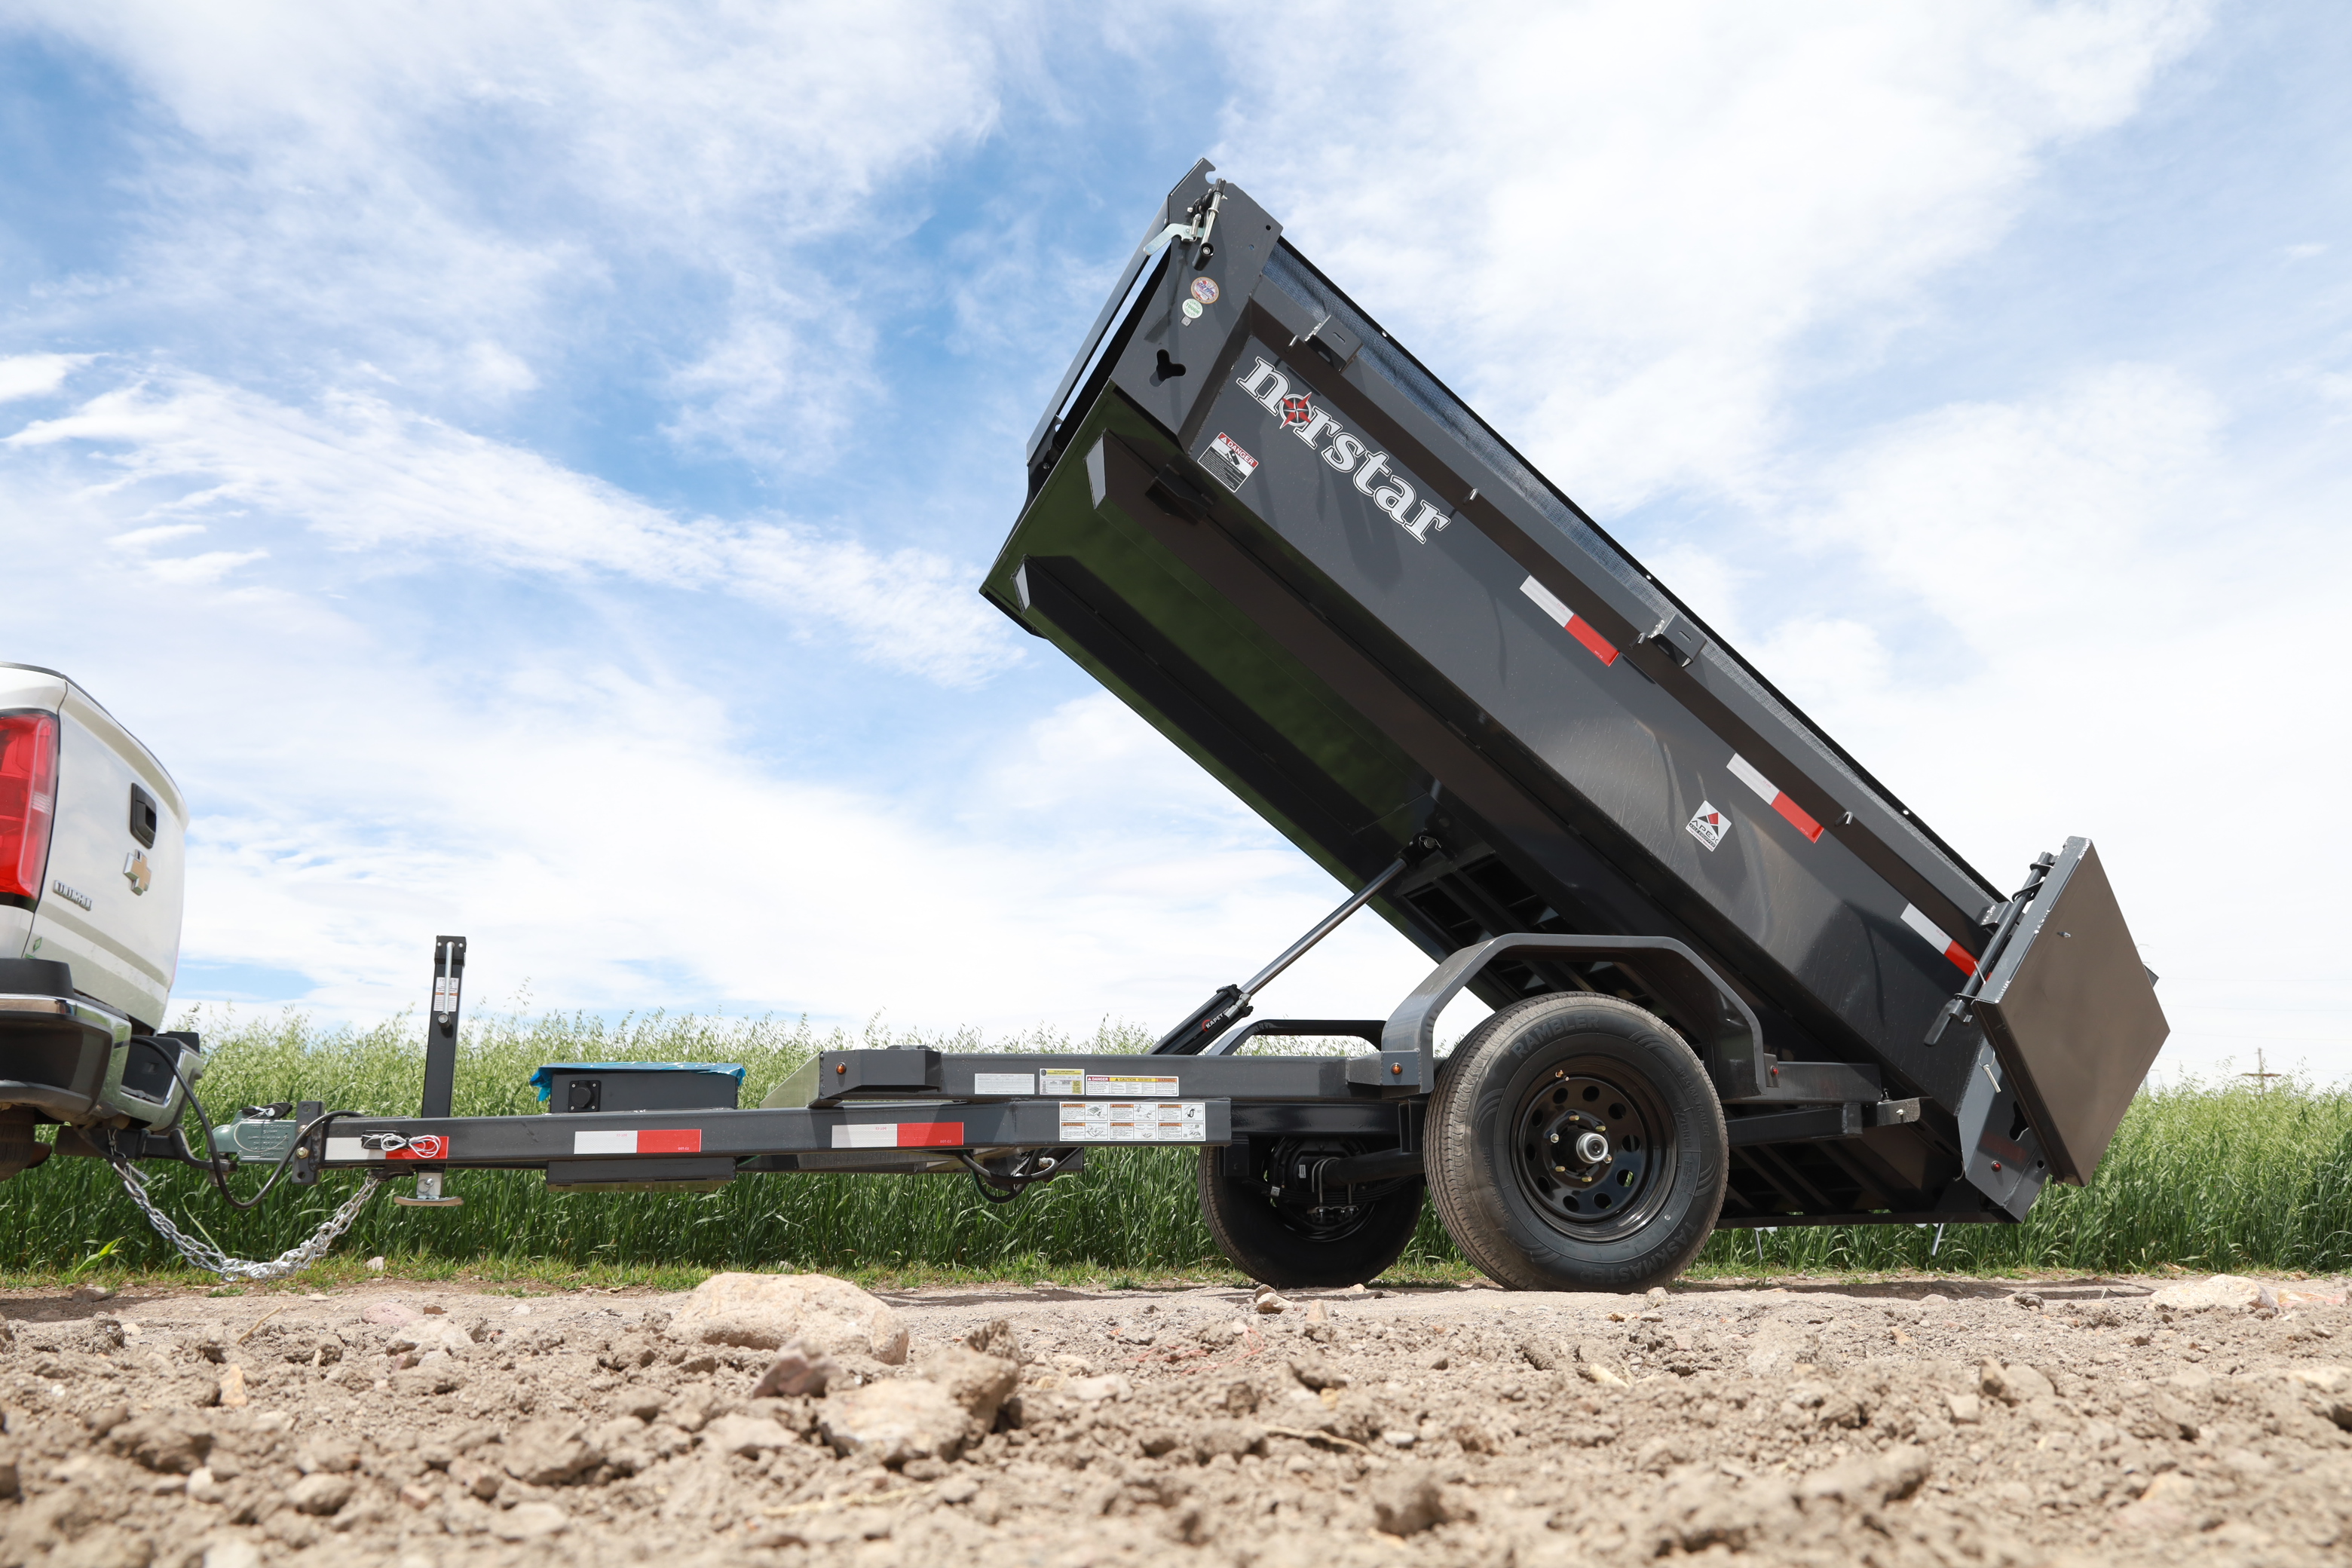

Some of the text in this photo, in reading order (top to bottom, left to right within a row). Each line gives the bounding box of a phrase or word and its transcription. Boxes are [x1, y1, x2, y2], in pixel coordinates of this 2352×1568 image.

[1186, 302, 1200, 314] TOUGH
[1227, 441, 1254, 465] DANGER
[1236, 356, 1452, 545] norstar
[1691, 819, 1720, 844] APEX
[1205, 1012, 1223, 1029] KAPET
[1511, 1013, 1600, 1060] RAMBLER
[1676, 1065, 1710, 1138] SPECIAL TRAILER
[1579, 1221, 1699, 1284] TASKMASTER
